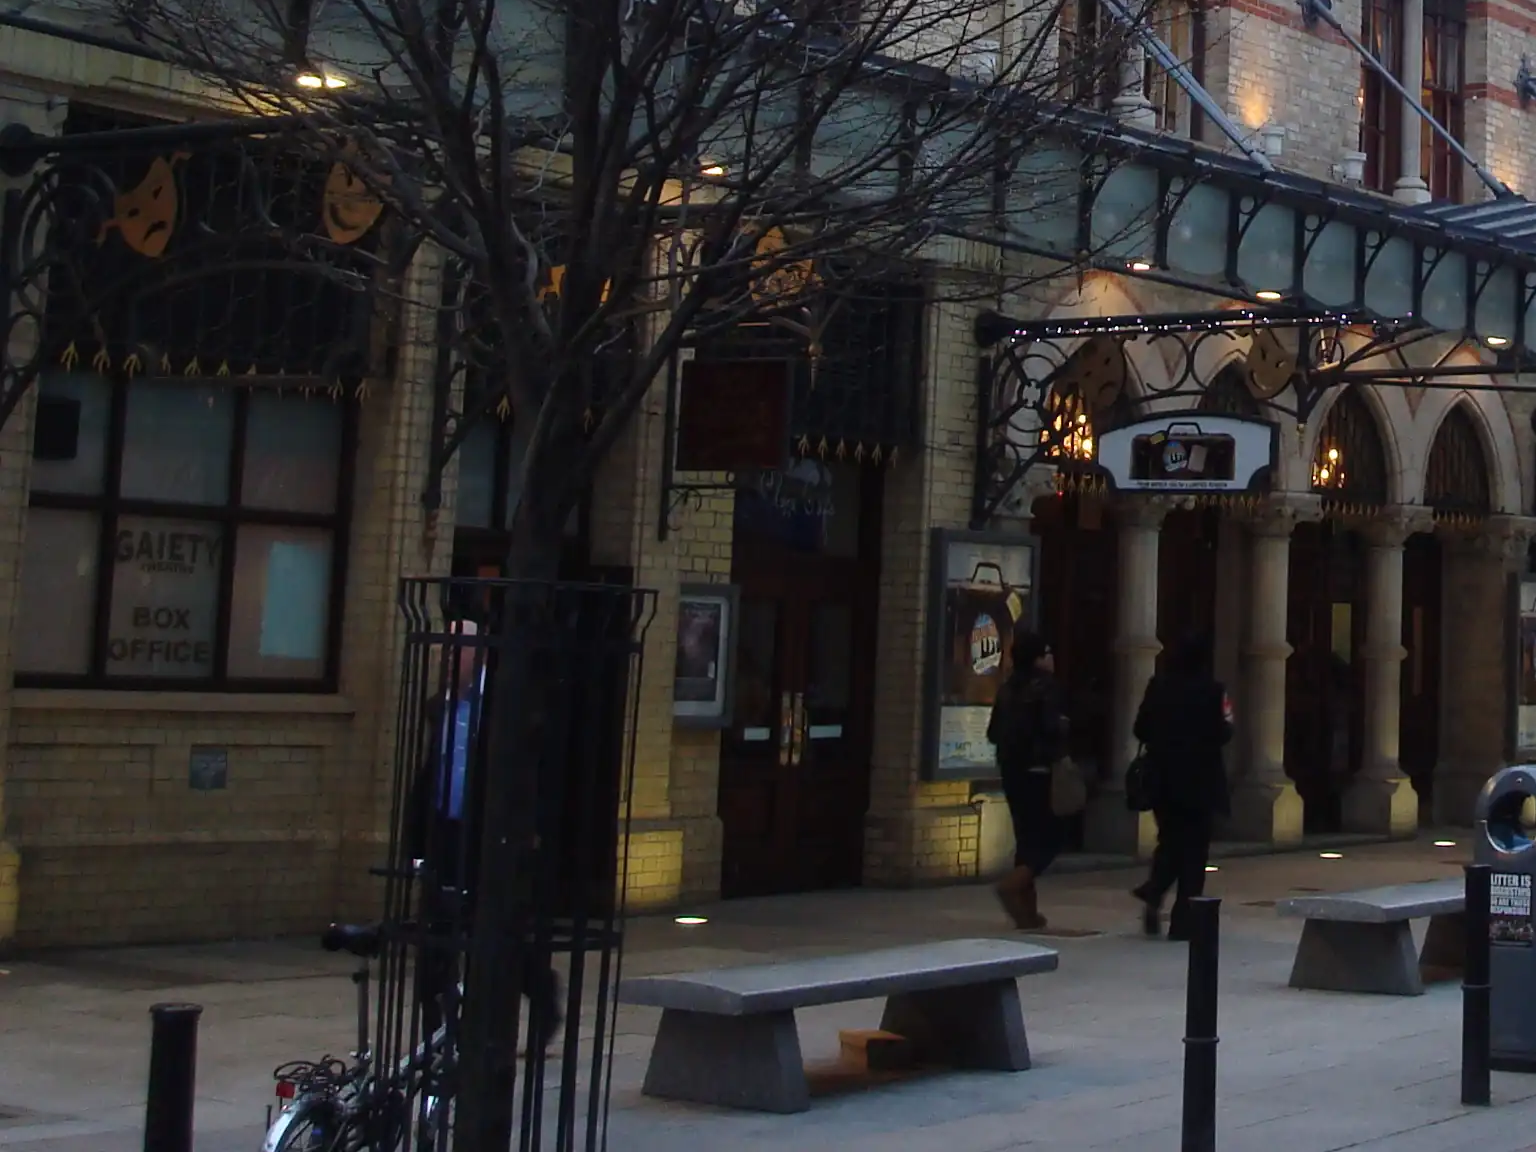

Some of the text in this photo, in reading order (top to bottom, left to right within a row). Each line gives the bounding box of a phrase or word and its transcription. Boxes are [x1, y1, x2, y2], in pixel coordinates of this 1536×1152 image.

[114, 530, 222, 567] GAIETY
[133, 606, 191, 630] BOX
[107, 637, 210, 664] OFFICE
[1490, 873, 1532, 888] LITTER IS
